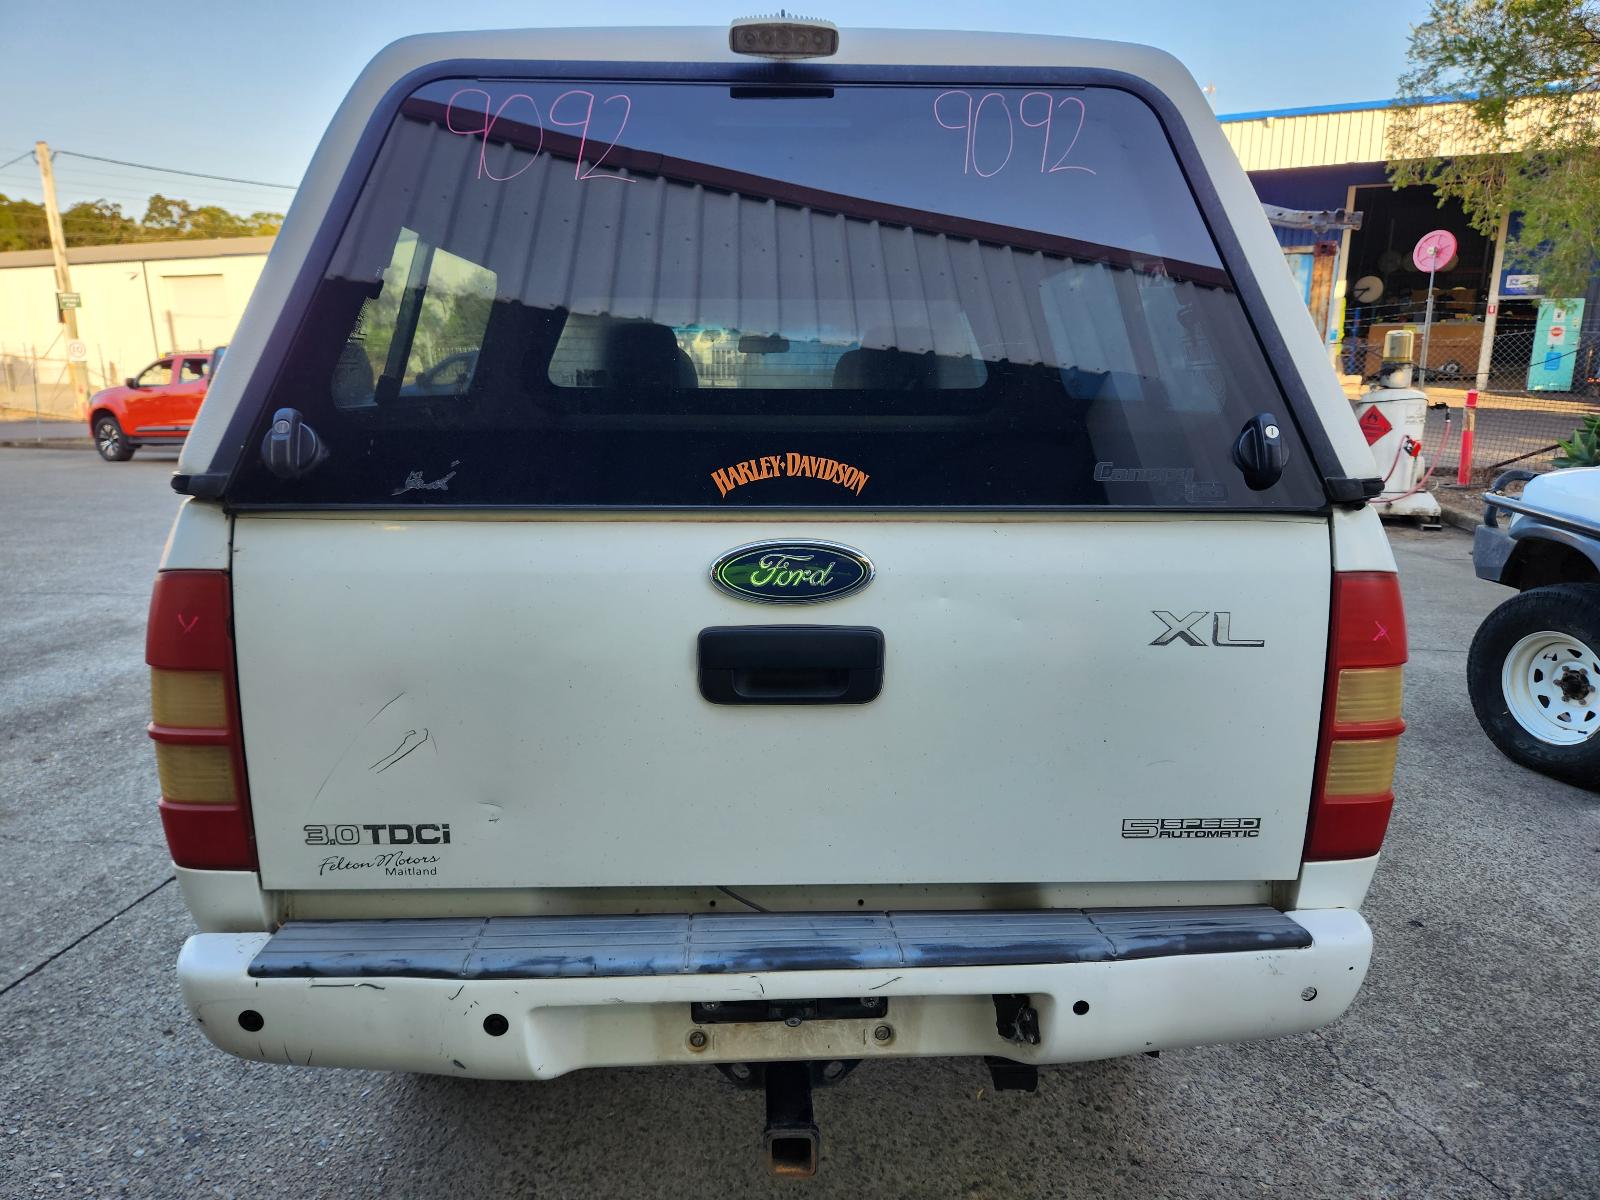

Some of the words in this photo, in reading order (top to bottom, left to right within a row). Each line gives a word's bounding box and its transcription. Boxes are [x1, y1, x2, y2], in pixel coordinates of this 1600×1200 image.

[446, 88, 637, 183] 9092
[934, 90, 1096, 178] 9092
[751, 553, 836, 587] Ford
[1148, 610, 1265, 647] XL
[303, 824, 360, 846] 3.0
[363, 823, 451, 845] TDCi
[1121, 818, 1159, 839] 5
[1161, 817, 1261, 830] SPEED
[1158, 829, 1260, 839] AUTOMATIC
[319, 855, 375, 876] Felton
[374, 850, 441, 868] Motors
[385, 867, 437, 876] Maitland
